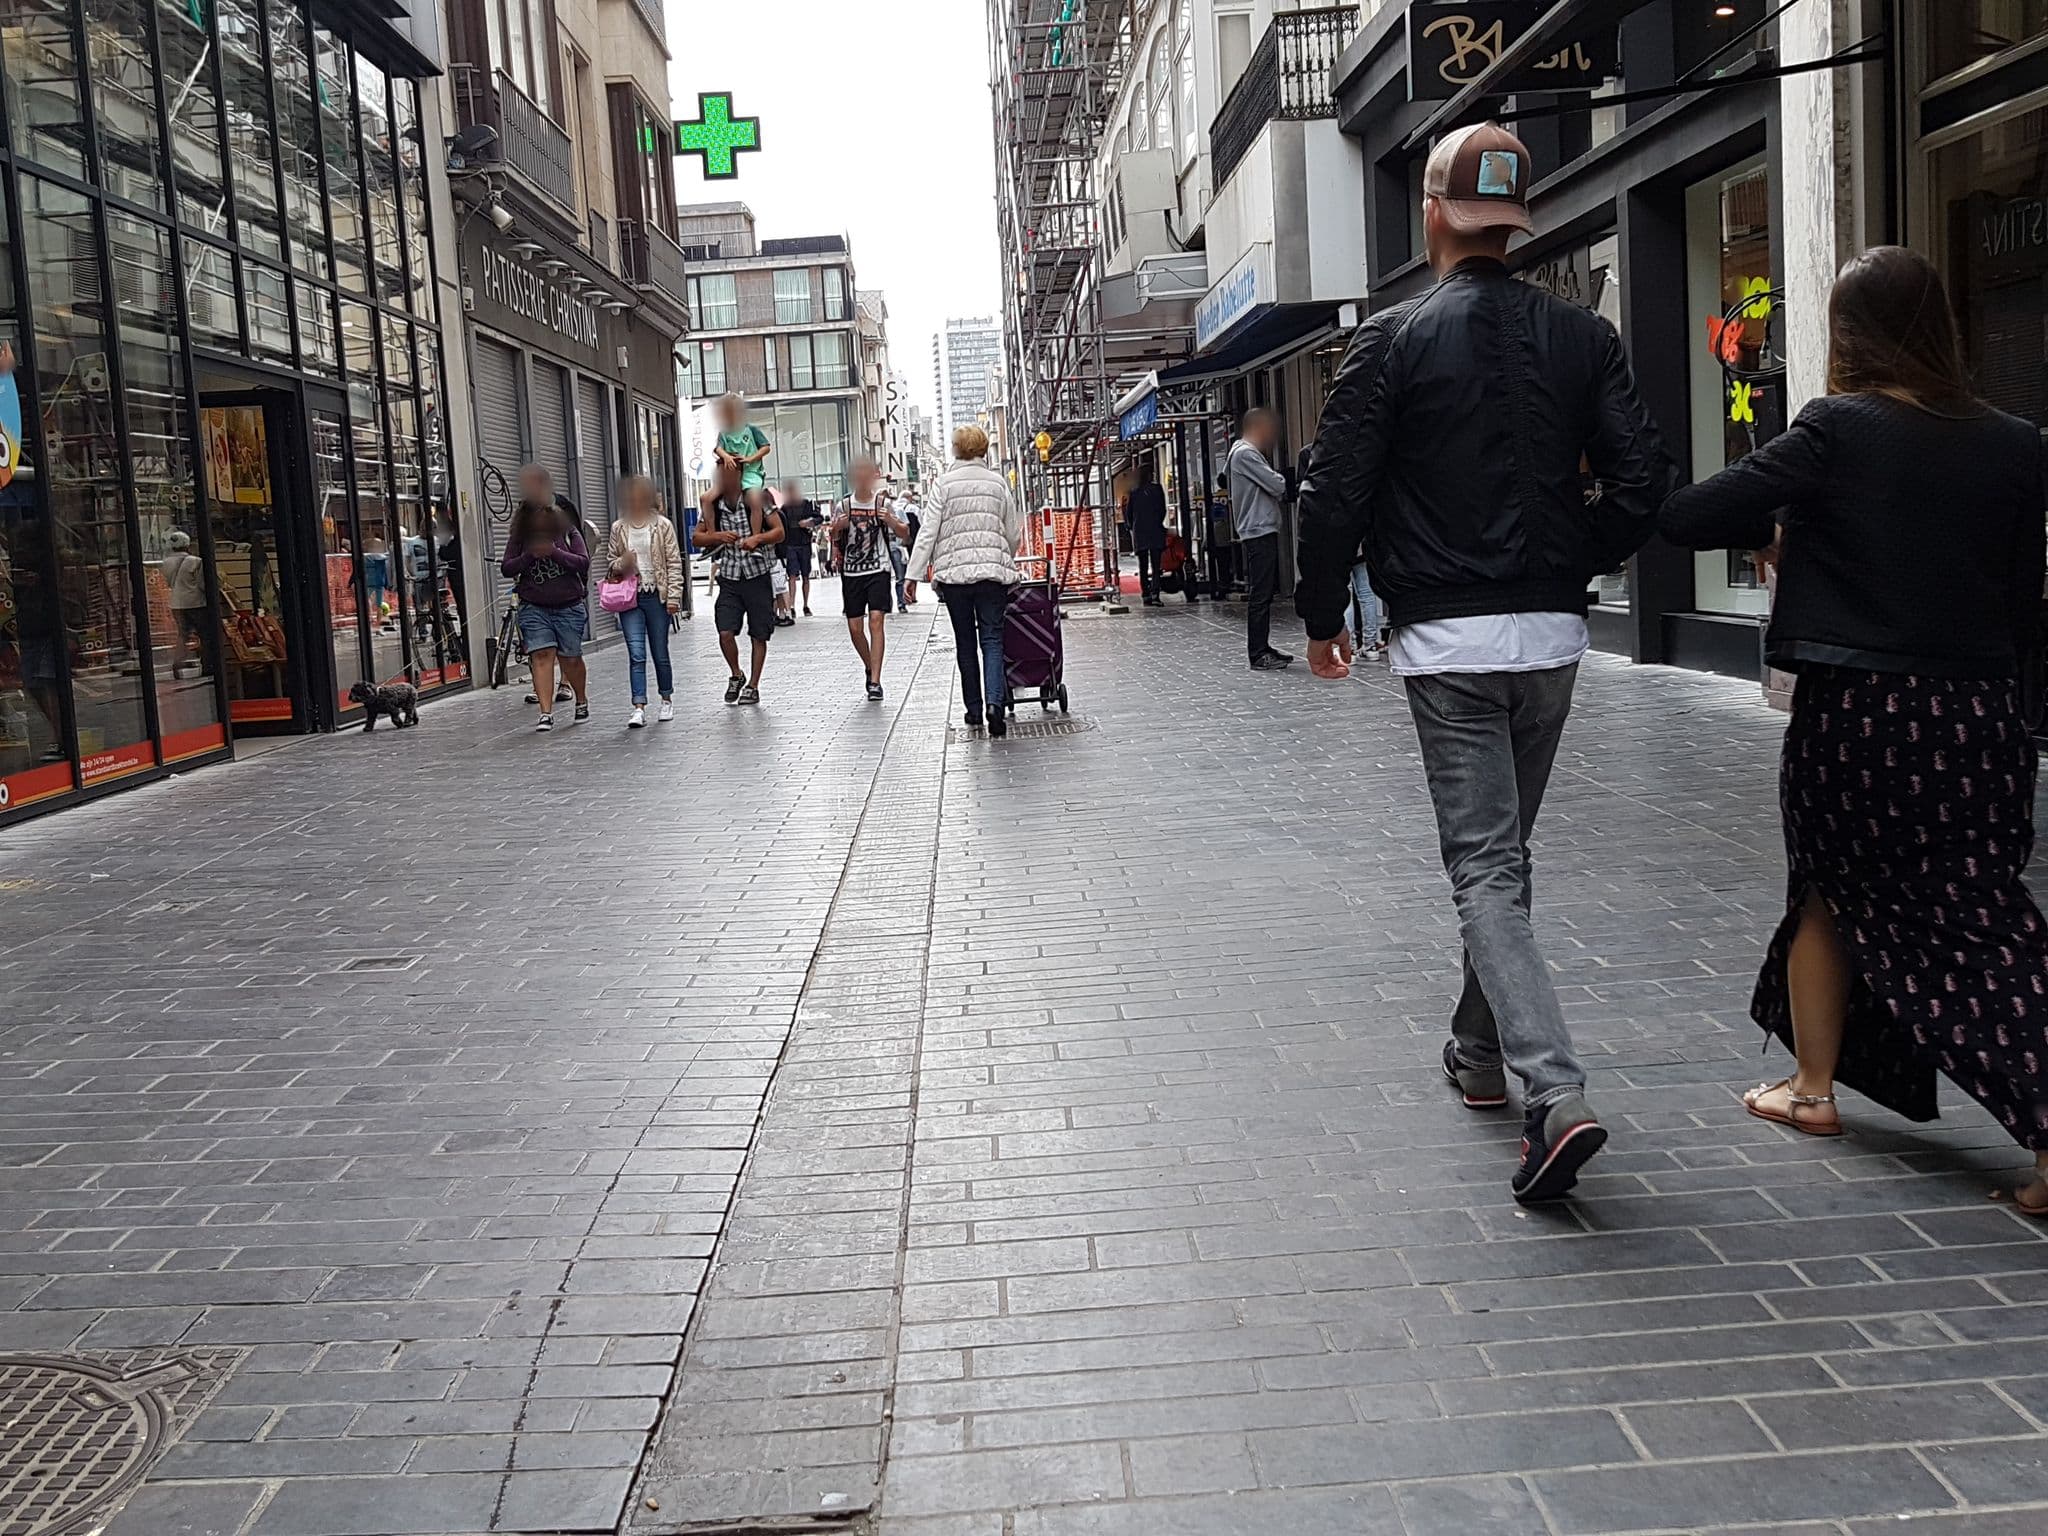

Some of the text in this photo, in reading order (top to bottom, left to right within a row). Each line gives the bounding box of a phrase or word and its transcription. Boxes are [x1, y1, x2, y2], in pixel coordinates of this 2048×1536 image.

[481, 245, 600, 351] PATISSERIE CHRISTINA
[886, 381, 904, 473] SKIN
